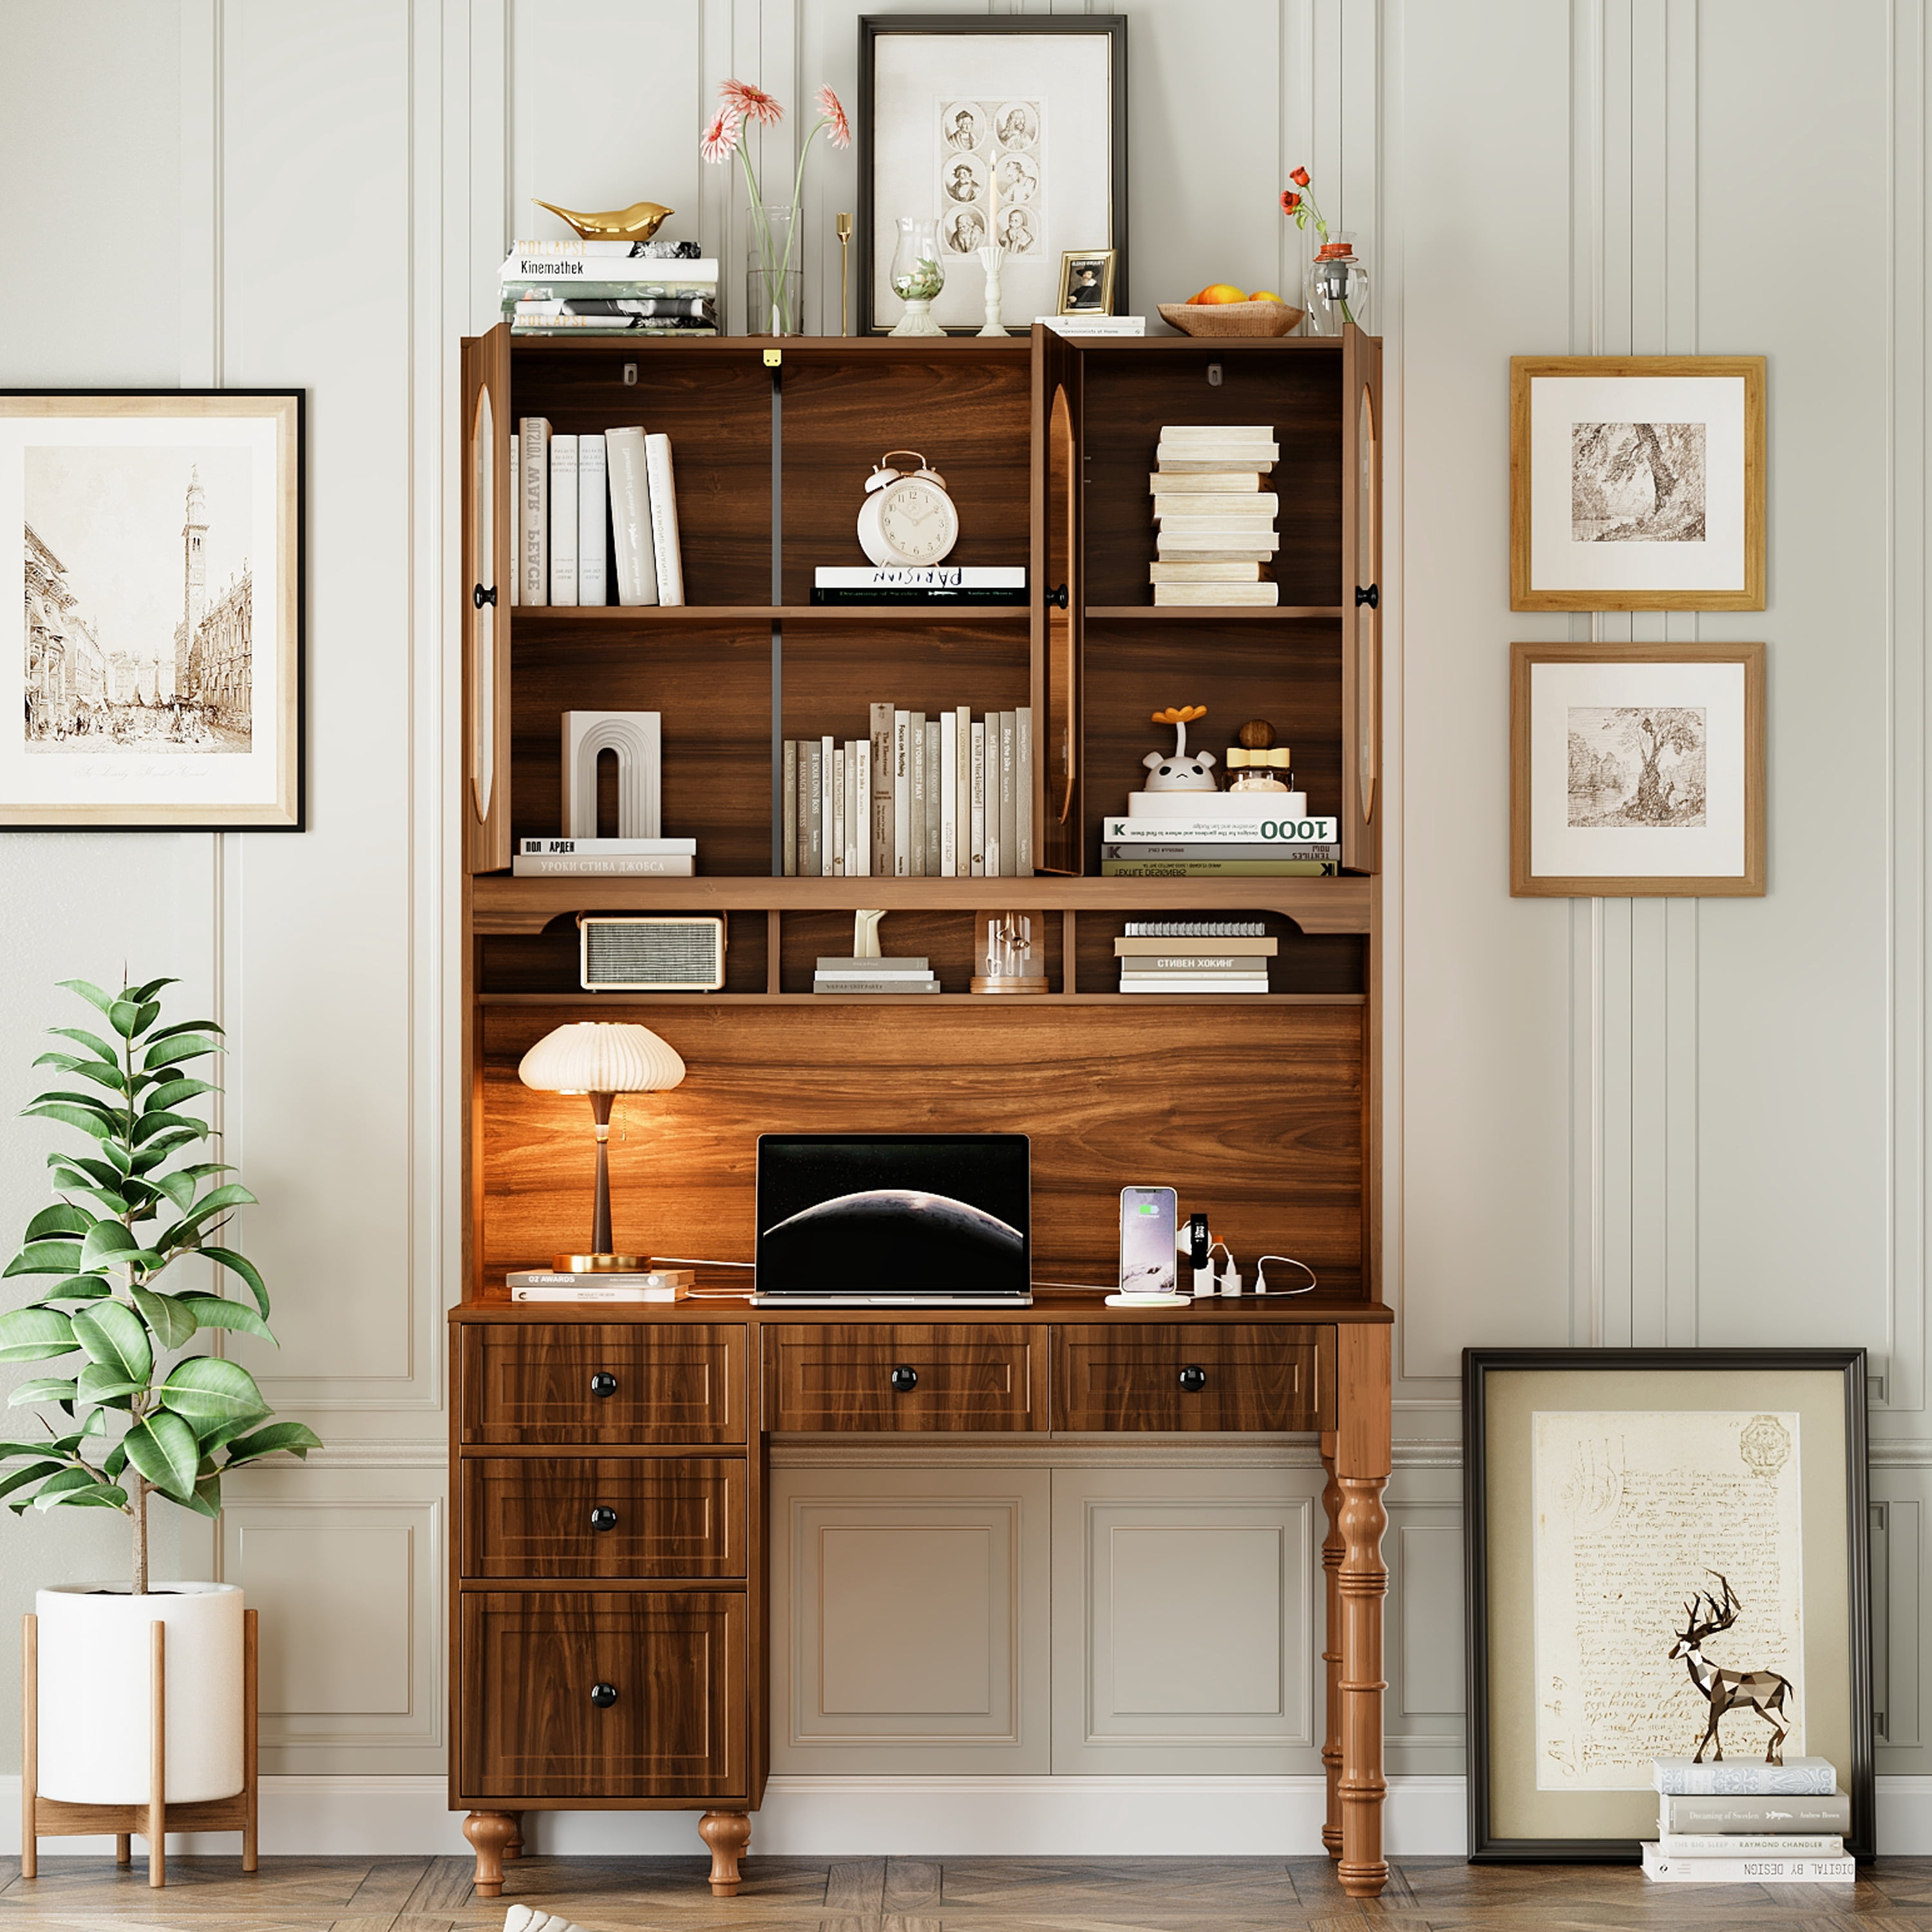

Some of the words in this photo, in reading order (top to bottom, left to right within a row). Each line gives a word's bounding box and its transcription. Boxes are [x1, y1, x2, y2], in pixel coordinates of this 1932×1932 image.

[518, 241, 587, 256] COLLAPSE
[520, 260, 584, 274] Kinemathek
[518, 316, 587, 327] COLLAPSE
[873, 567, 962, 587] PARISIAN
[899, 743, 904, 751] on
[897, 752, 905, 777] Nothing
[972, 762, 982, 804] Mockingbird
[1261, 821, 1328, 839] 1000
[526, 841, 541, 852] ПОЛ
[549, 841, 574, 853] АРДЕН
[541, 862, 577, 871] УРОКИ
[580, 862, 616, 871] СТИВА
[618, 862, 664, 872] ДЖОБСА
[1157, 959, 1195, 967] СТИВЕН
[1197, 959, 1234, 967] ХОКИНГ
[1690, 1812, 1723, 1821] Dreaming
[1724, 1811, 1732, 1819] of
[1732, 1811, 1759, 1819] Sweden
[1744, 1864, 1784, 1875] DESIGN
[1791, 1864, 1803, 1875] BY
[1811, 1864, 1853, 1875] DIGITAL
